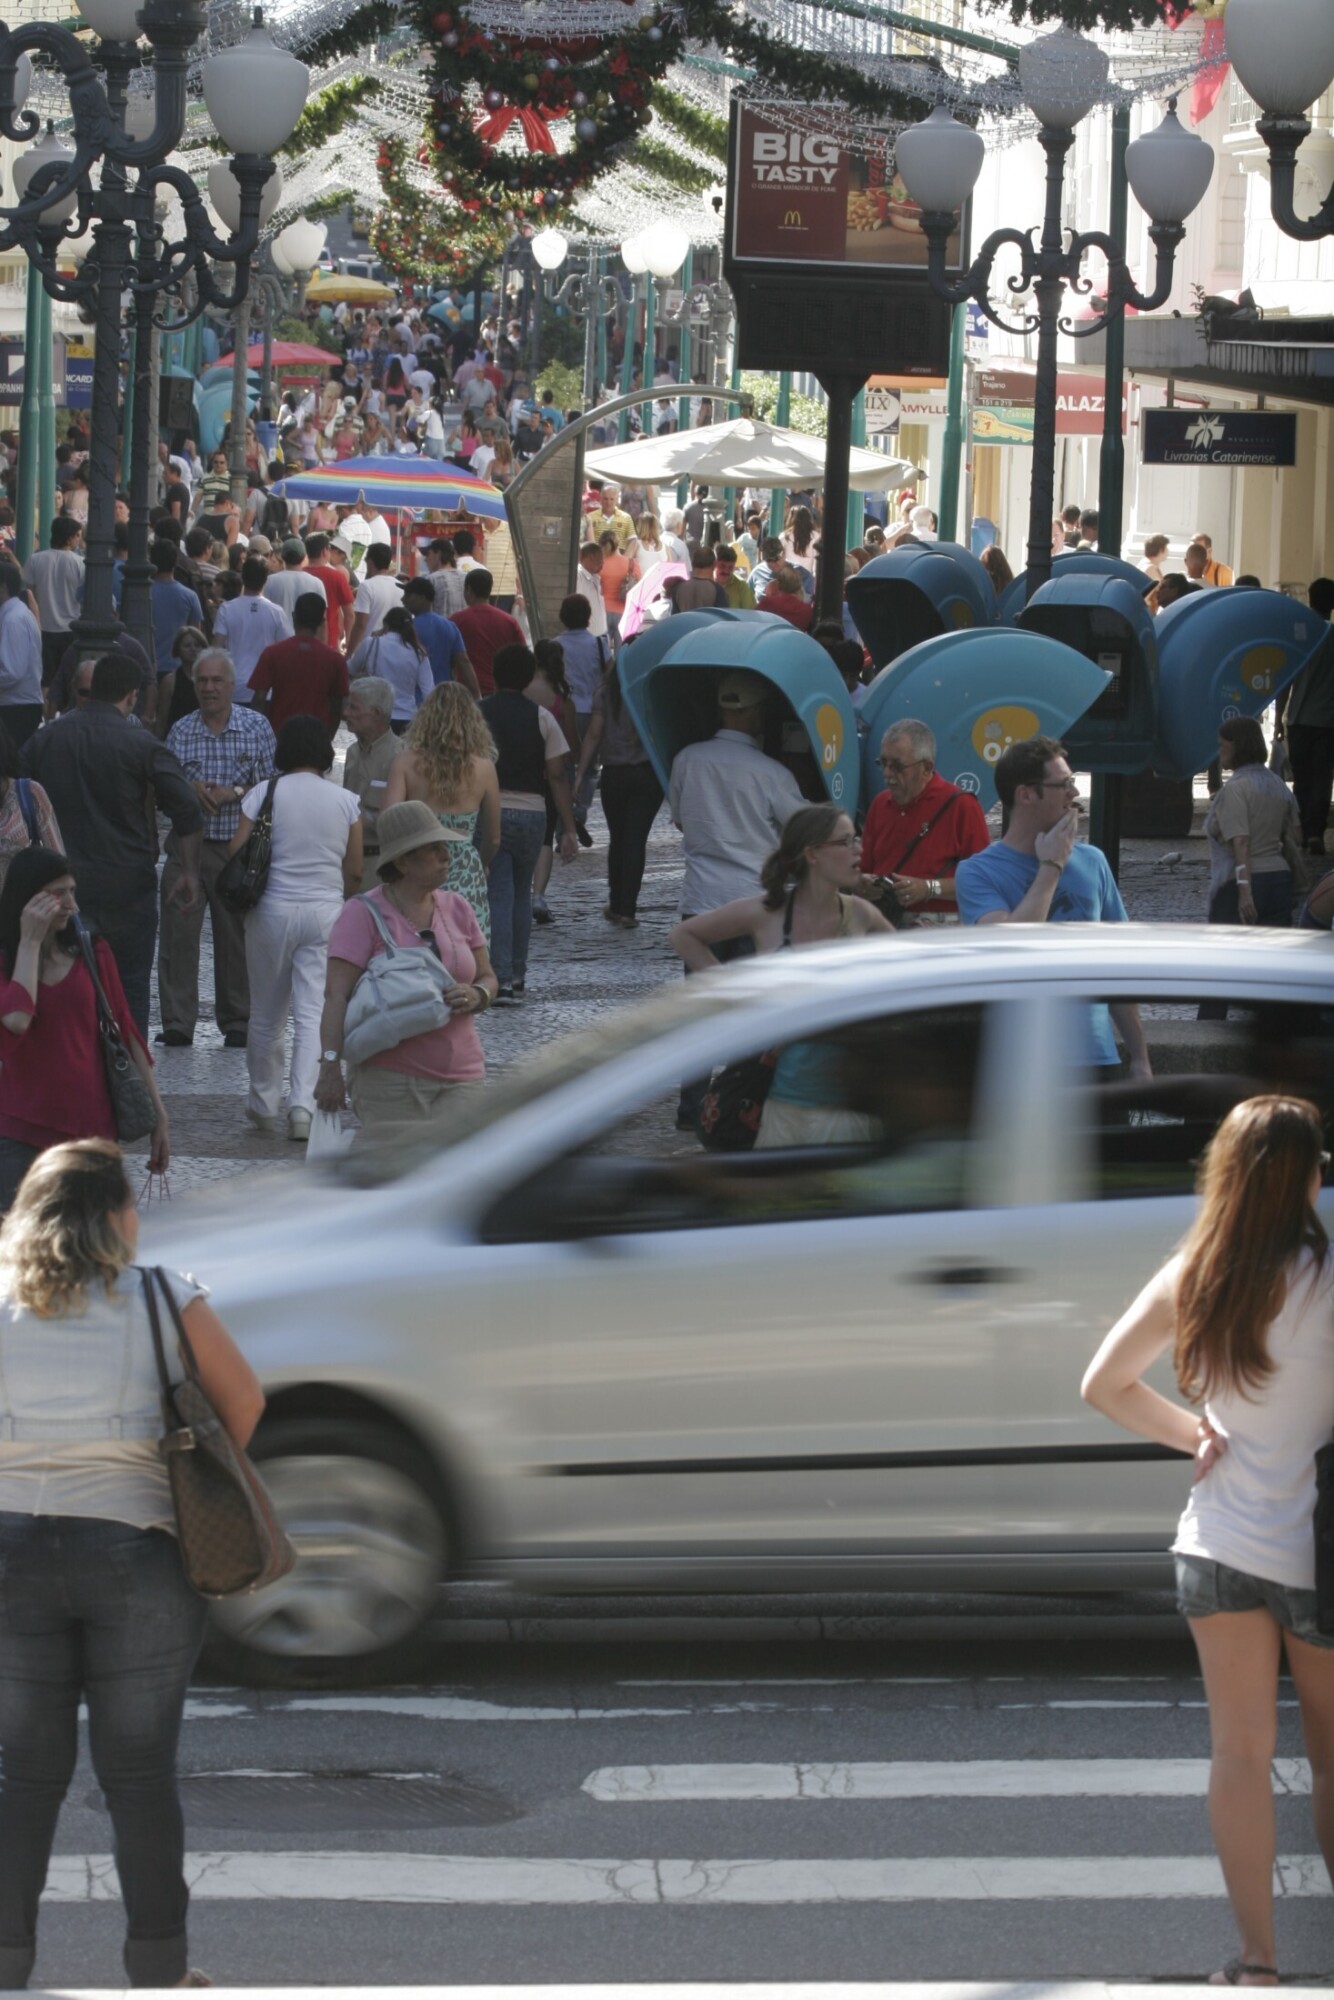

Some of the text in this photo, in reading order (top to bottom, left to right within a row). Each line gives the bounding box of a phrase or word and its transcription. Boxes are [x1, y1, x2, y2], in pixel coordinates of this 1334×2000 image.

[753, 132, 839, 164] BIG
[753, 165, 838, 184] TASTY
[982, 381, 1006, 389] Trajano
[1055, 395, 1127, 412] ALAZ
[1164, 450, 1276, 463] Livrarias Catarinense
[1251, 668, 1271, 690] oi
[824, 734, 836, 763] oi
[960, 780, 974, 792] 31
